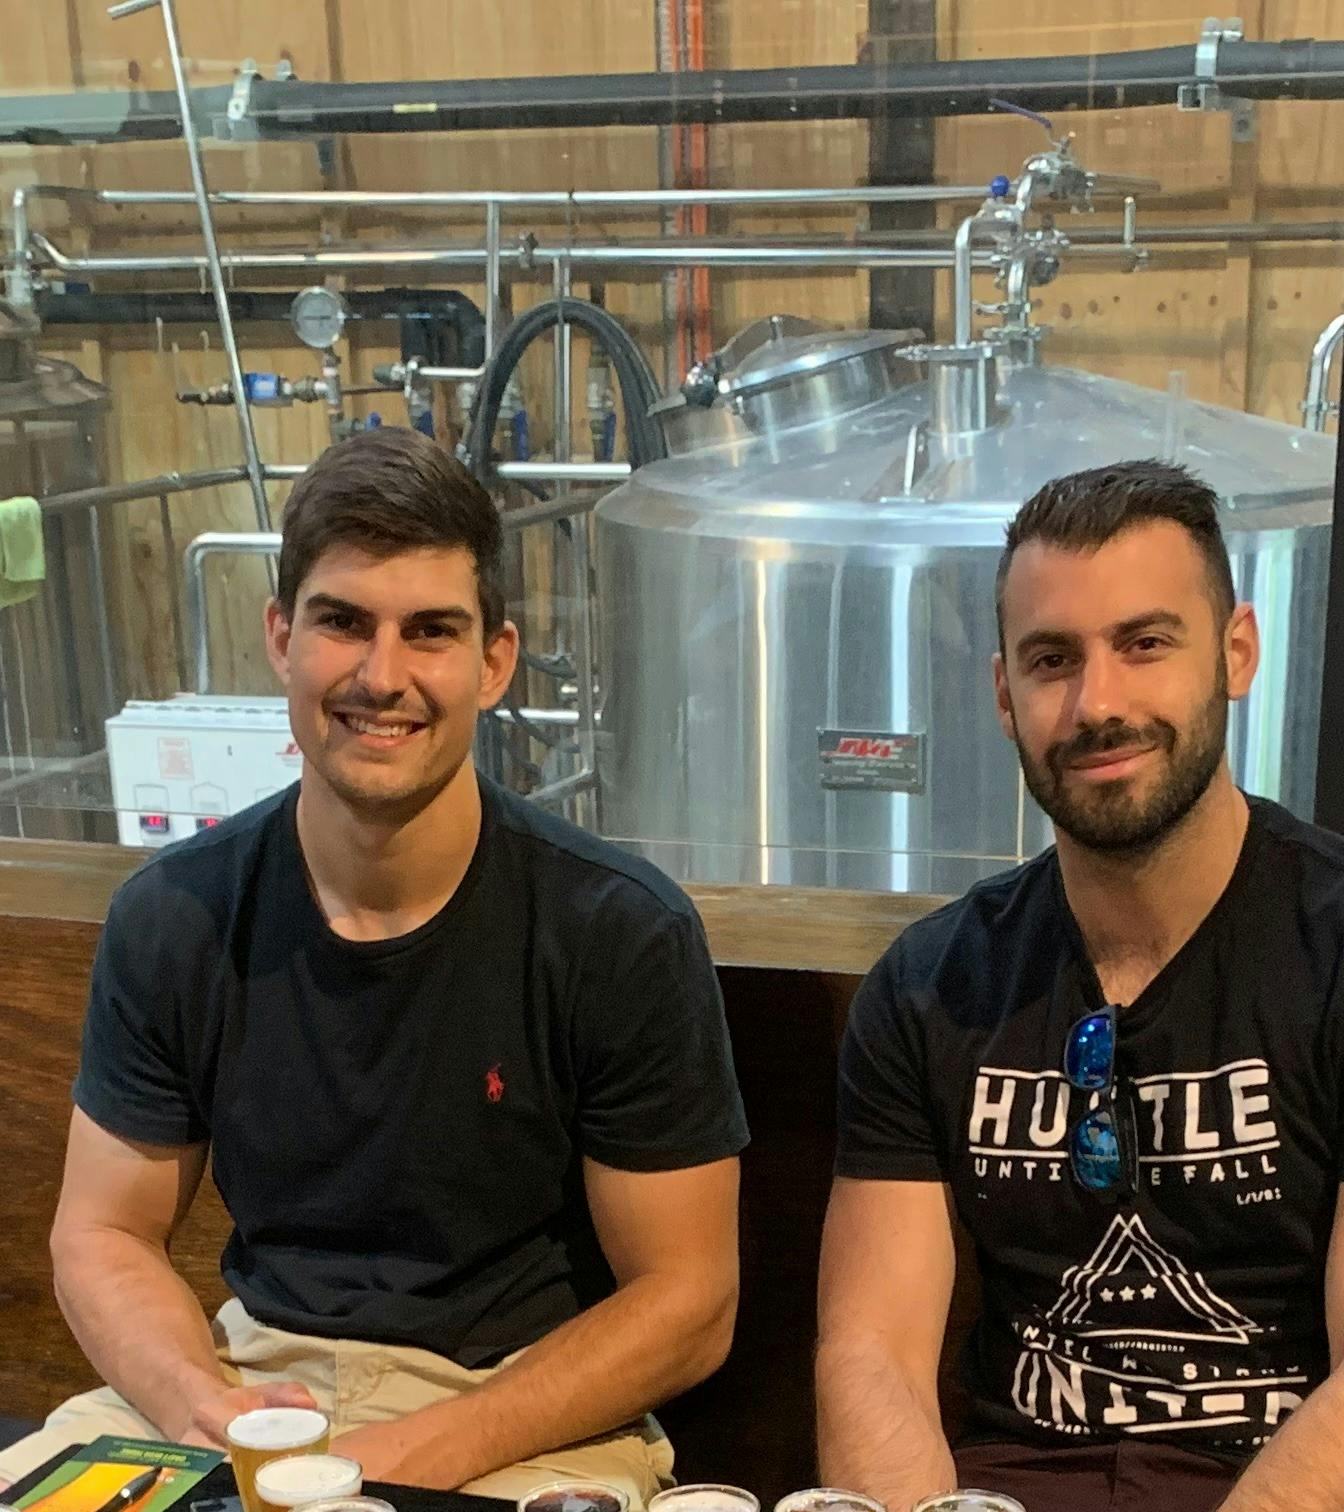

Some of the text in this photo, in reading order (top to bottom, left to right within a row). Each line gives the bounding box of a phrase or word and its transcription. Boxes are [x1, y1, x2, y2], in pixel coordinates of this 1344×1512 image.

[968, 1067, 1278, 1151] HUTLE
[974, 1157, 1063, 1182] UNTI
[1183, 1154, 1277, 1184] FALL
